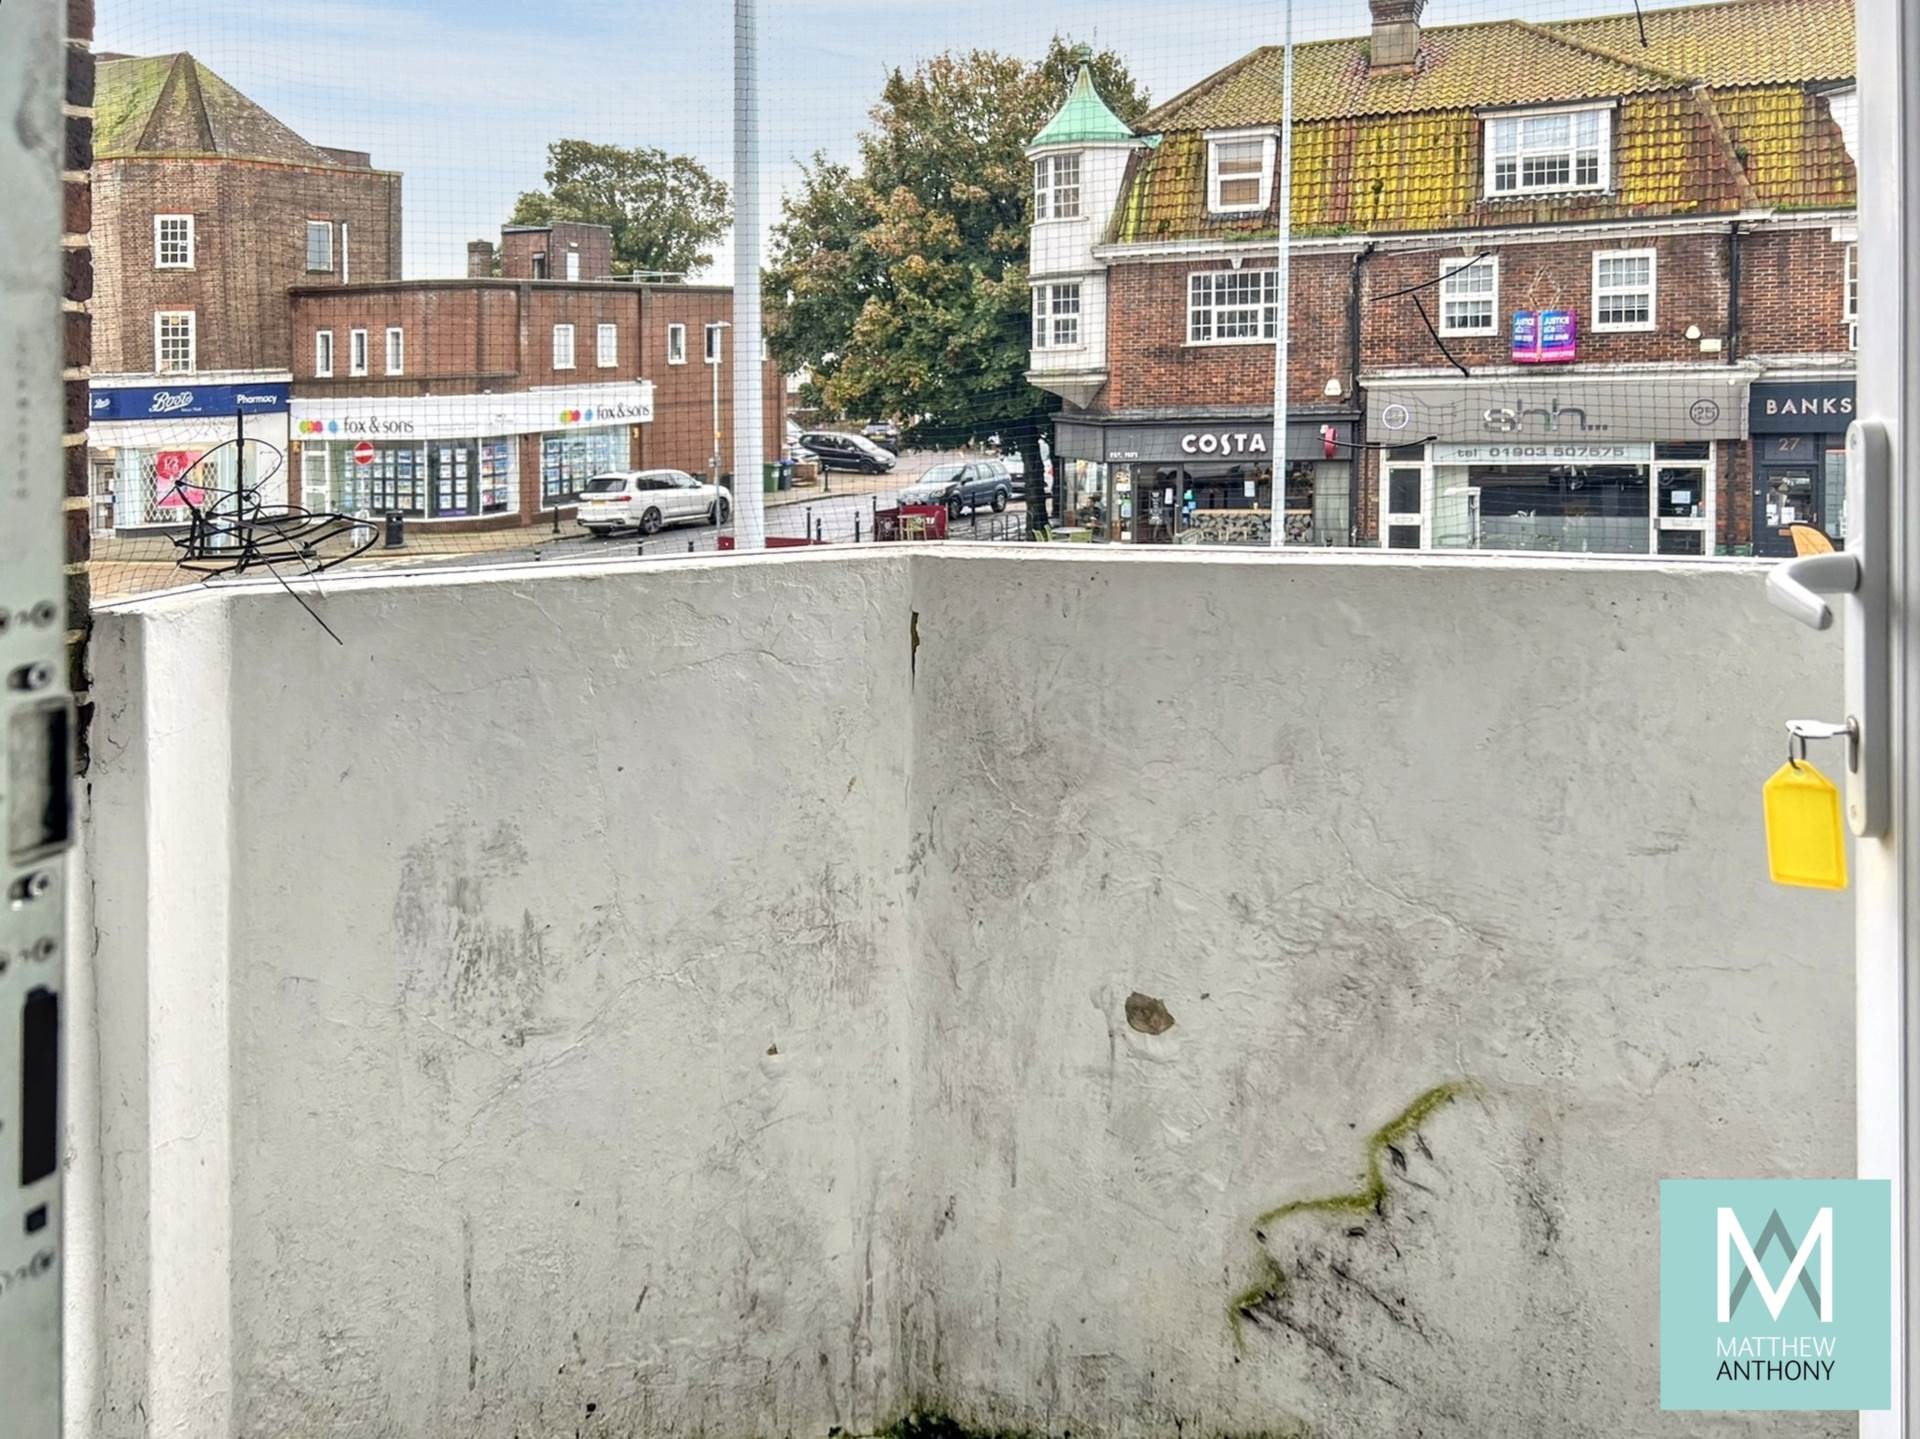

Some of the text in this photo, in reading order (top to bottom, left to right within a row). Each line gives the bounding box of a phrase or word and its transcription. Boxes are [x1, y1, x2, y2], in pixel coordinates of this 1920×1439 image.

[148, 391, 194, 412] Boots
[236, 394, 278, 405] Pharmacy
[1766, 398, 1852, 414] BANKS
[596, 402, 650, 420] fox & sons
[1694, 406, 1715, 420] 25
[344, 416, 366, 433] fox
[369, 416, 380, 433] &
[382, 421, 414, 433] sons
[1181, 433, 1266, 456] COSTA
[1457, 447, 1477, 458] tel
[1489, 447, 1547, 457] 01903
[1779, 438, 1800, 451] 27
